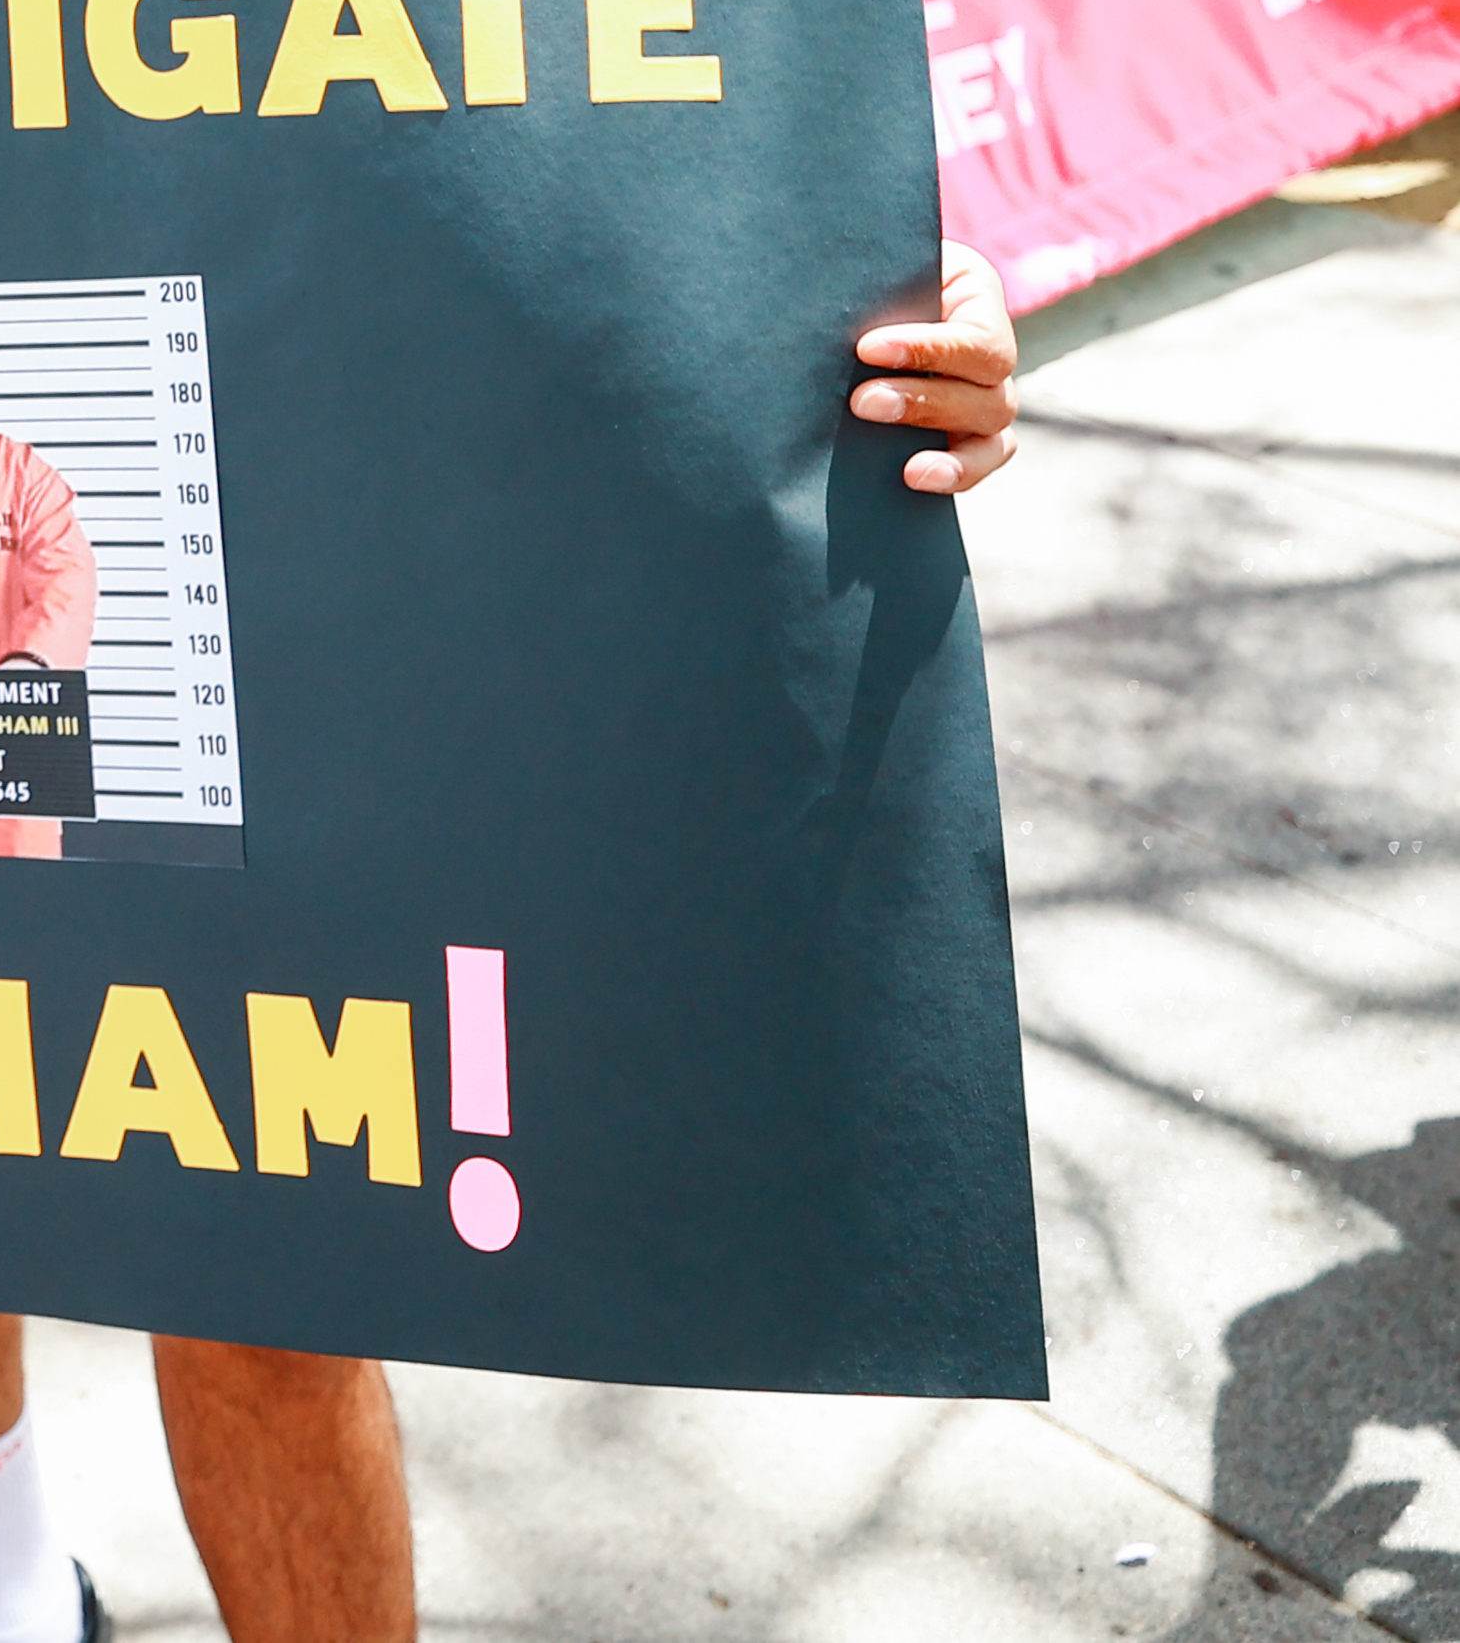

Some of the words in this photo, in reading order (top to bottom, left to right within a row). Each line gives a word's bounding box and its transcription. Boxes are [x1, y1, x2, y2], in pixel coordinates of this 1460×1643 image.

[160, 281, 197, 303] 200
[166, 331, 199, 354] 190
[170, 382, 203, 404] 180
[174, 432, 206, 455] 170
[177, 483, 210, 505] 160
[181, 534, 214, 556] 150
[184, 584, 218, 606] 140
[188, 634, 221, 655] 130
[192, 684, 226, 706] 120
[56, 716, 80, 736] III
[198, 734, 227, 756] 110
[199, 785, 232, 808] 100
